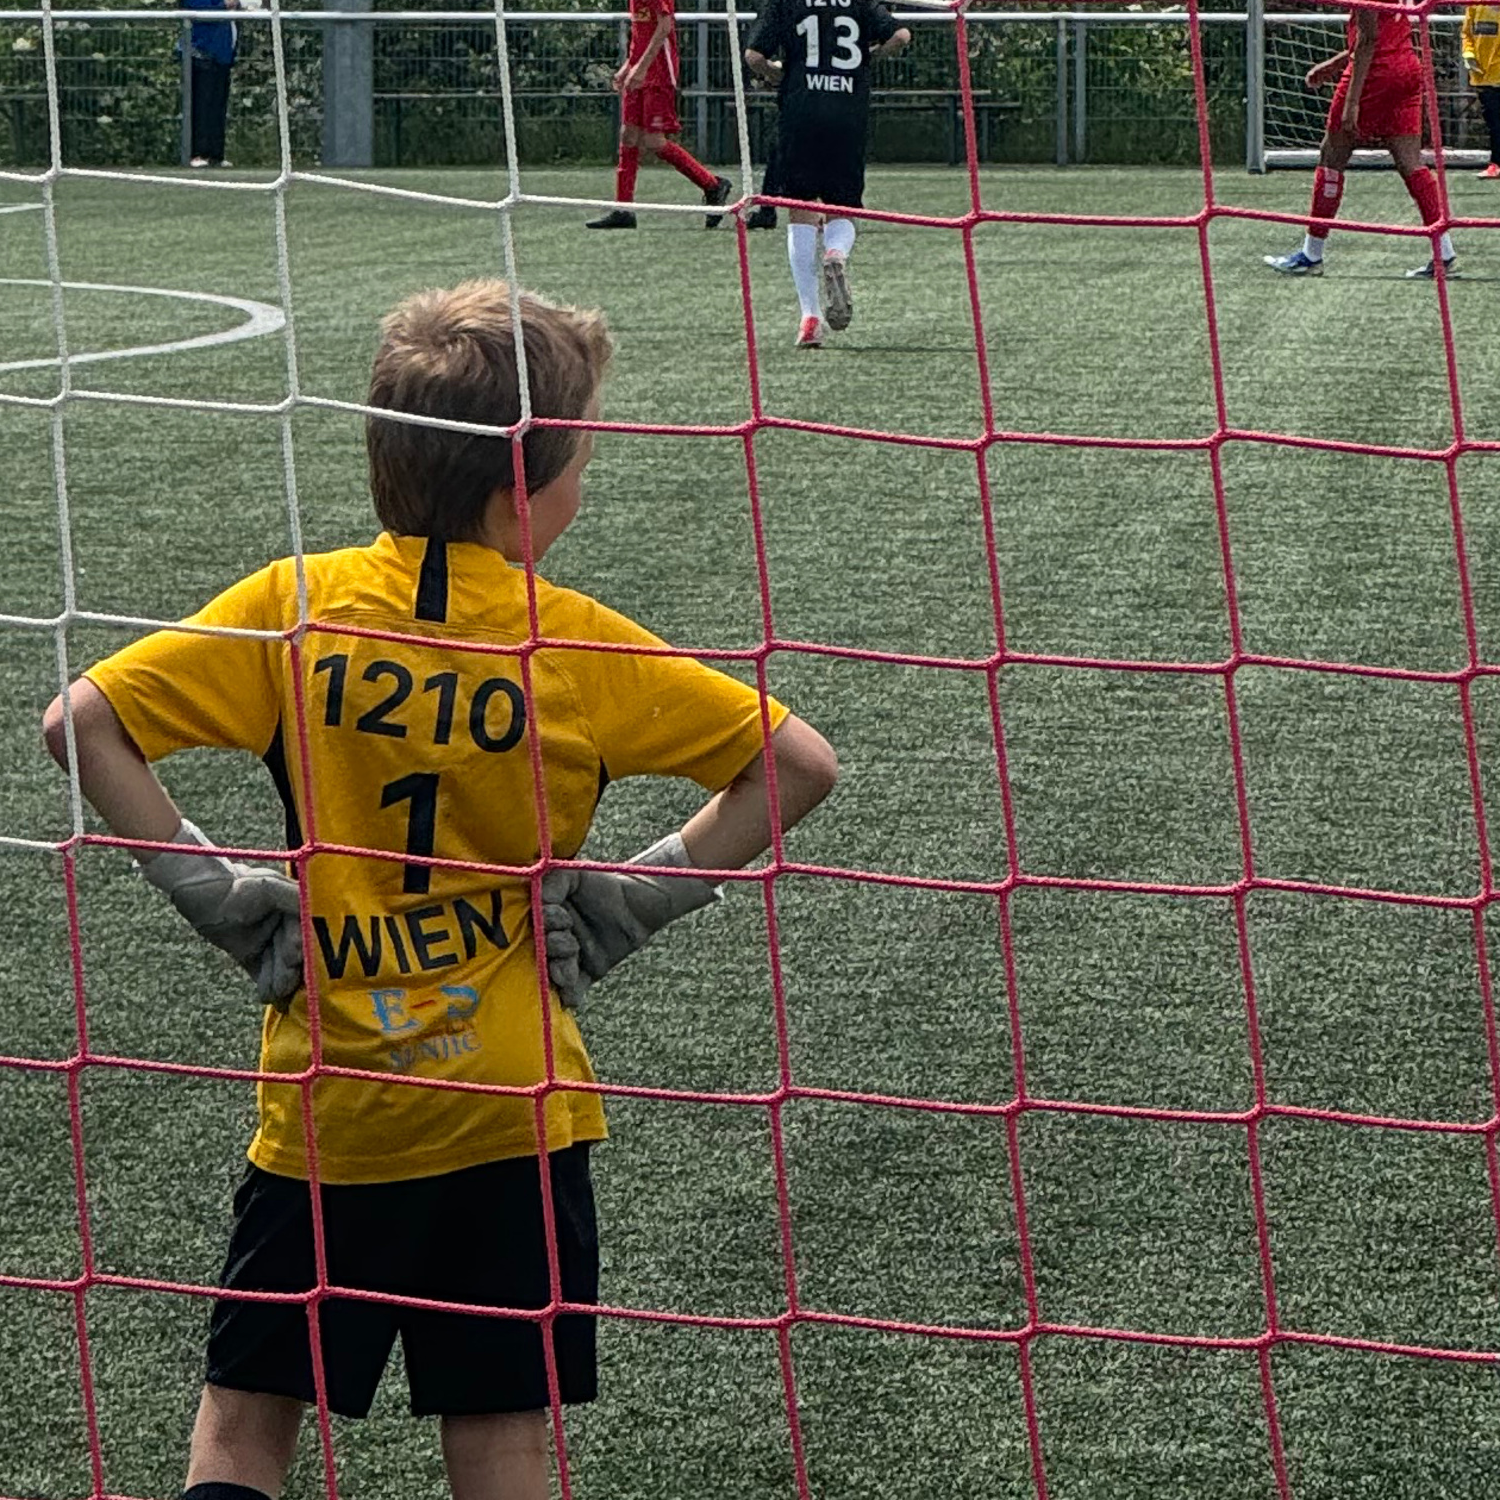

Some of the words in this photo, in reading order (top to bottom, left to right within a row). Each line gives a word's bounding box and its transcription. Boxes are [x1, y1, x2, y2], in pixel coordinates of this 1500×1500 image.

[796, 14, 863, 70] 13
[805, 73, 854, 94] WIEN
[313, 653, 527, 754] 1210
[379, 772, 440, 894] 1
[312, 890, 511, 980] WIEN
